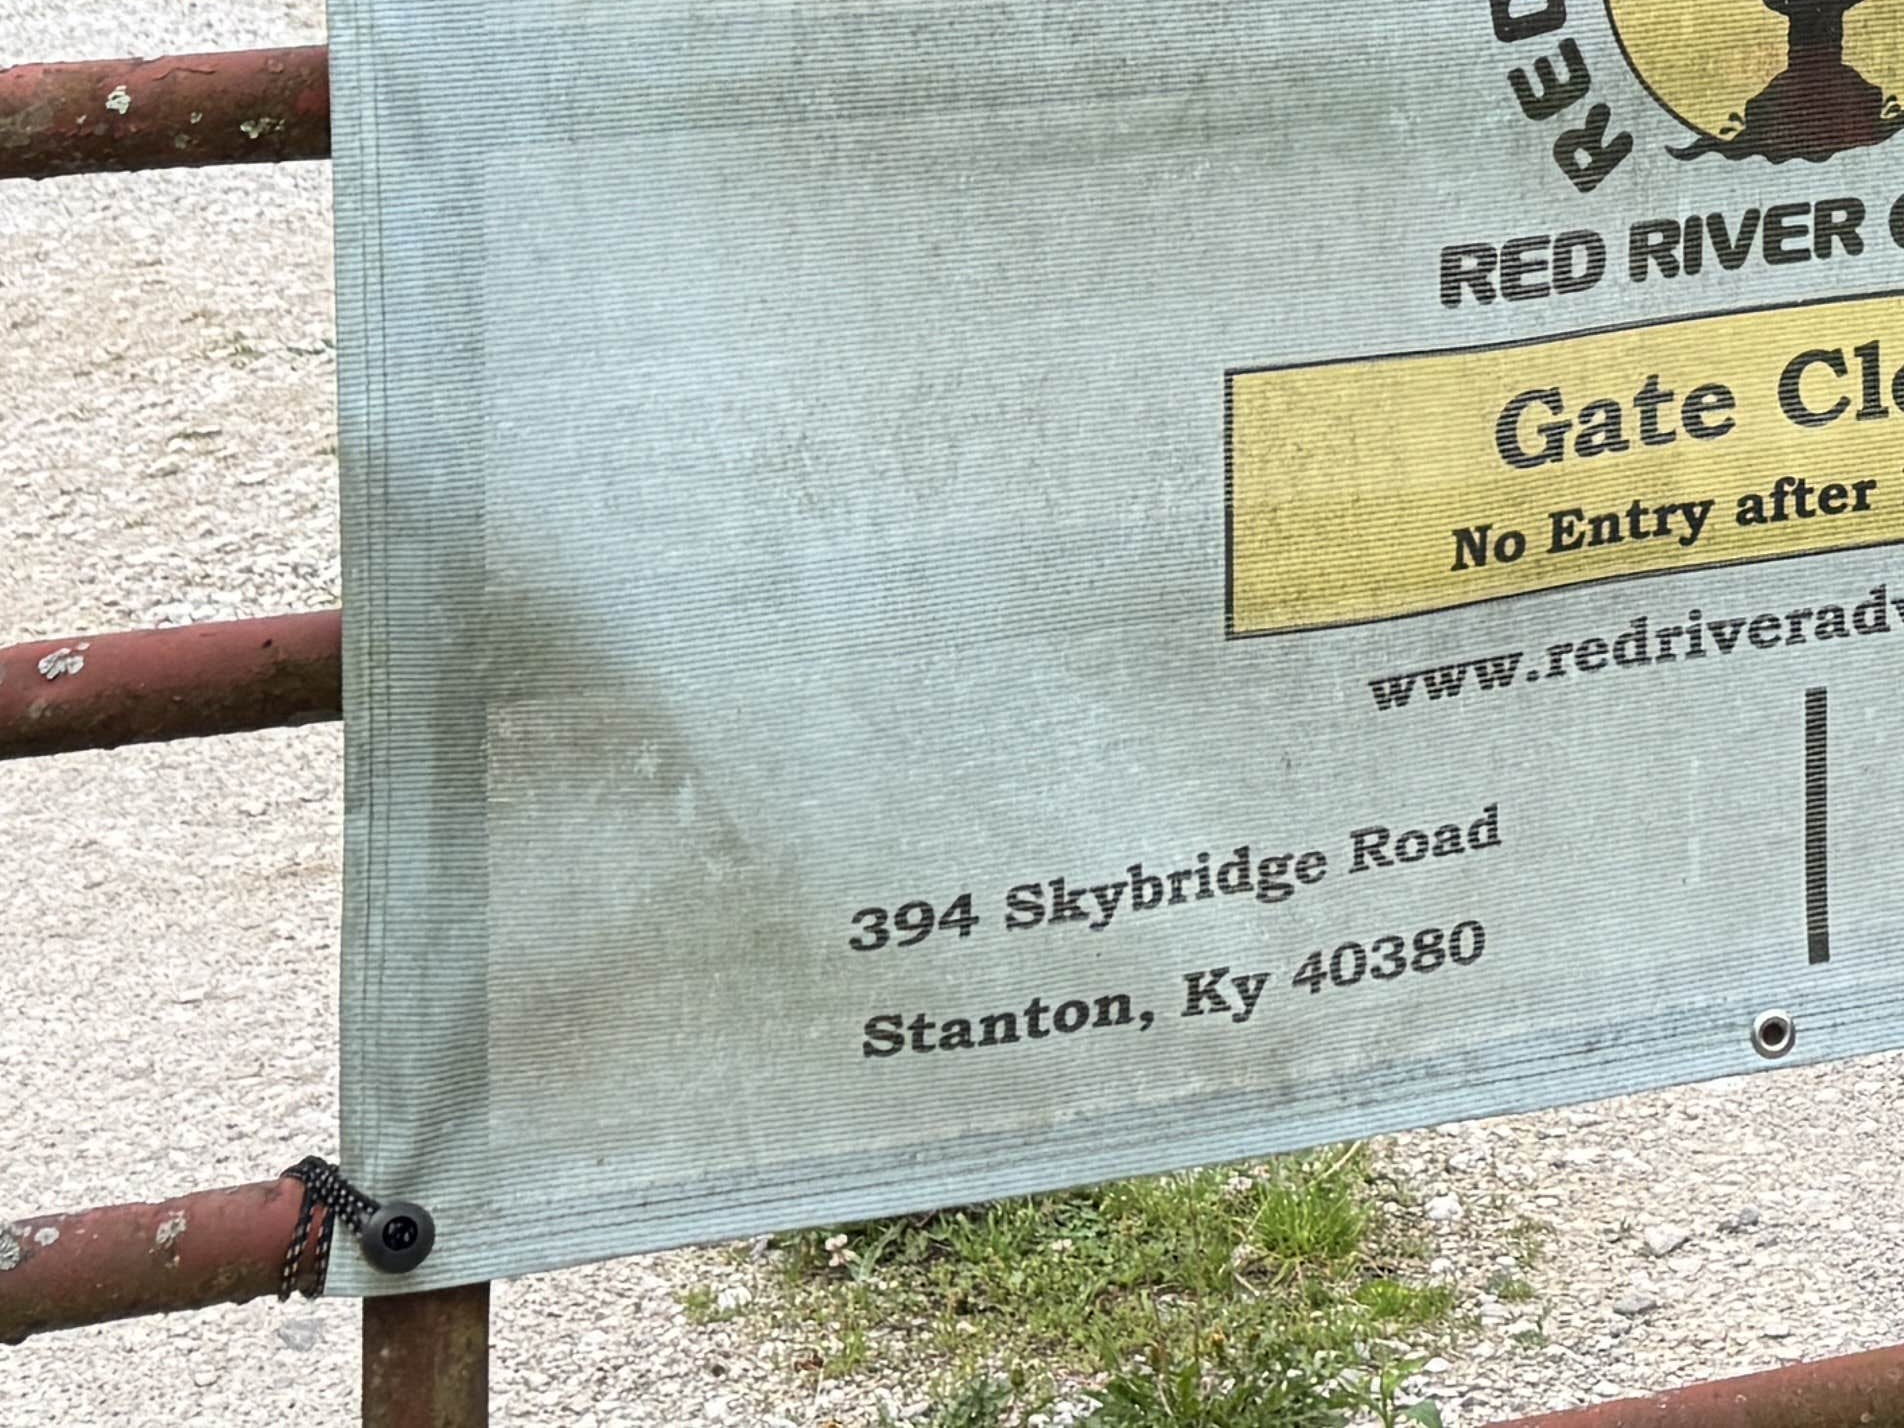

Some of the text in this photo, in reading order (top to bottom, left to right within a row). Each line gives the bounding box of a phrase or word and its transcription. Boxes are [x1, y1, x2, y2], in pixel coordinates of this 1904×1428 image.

[1440, 230, 1606, 309] RED
[1628, 196, 1863, 282] RIVER
[1495, 370, 1736, 470] Gate
[1451, 524, 1526, 573] No
[1547, 495, 1713, 556] Entry
[1735, 473, 1877, 529] after
[848, 803, 1501, 951] 394 Skybridge Road
[862, 920, 1486, 1058] Stanton, Ky 40380
